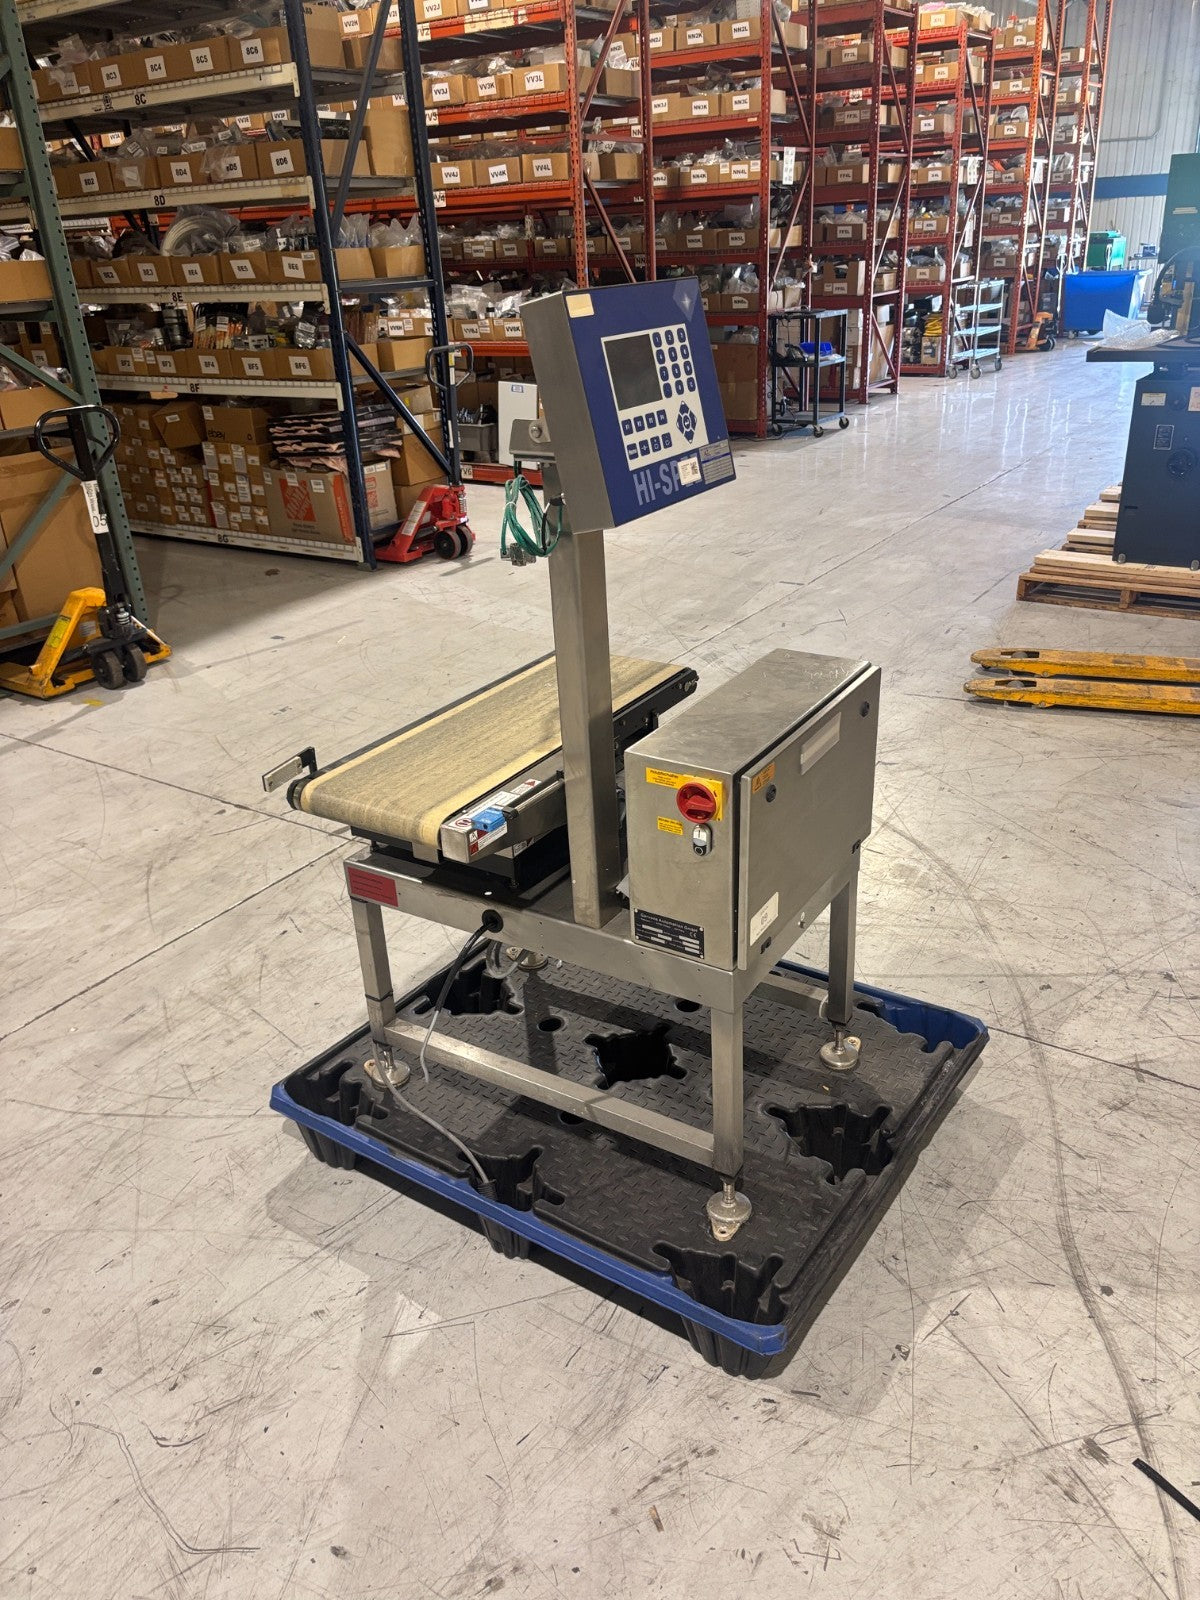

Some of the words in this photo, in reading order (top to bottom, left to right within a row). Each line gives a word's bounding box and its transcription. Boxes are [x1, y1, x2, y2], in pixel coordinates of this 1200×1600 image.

[426, 5, 440, 13] VV2J
[246, 46, 258, 56] 8C6
[196, 55, 208, 64] 8C5
[150, 63, 162, 72] 8C4
[526, 75, 544, 83] VV3L
[479, 82, 495, 90] VV3K
[134, 93, 146, 106] 8C
[276, 157, 288, 166] 8D6
[175, 168, 187, 176] 8D4
[490, 170, 507, 178] VV4K
[153, 195, 166, 206] 8D
[171, 292, 184, 302] 8E
[294, 362, 307, 370] 8F6
[189, 382, 200, 393] 8F
[217, 534, 230, 543] 8G
